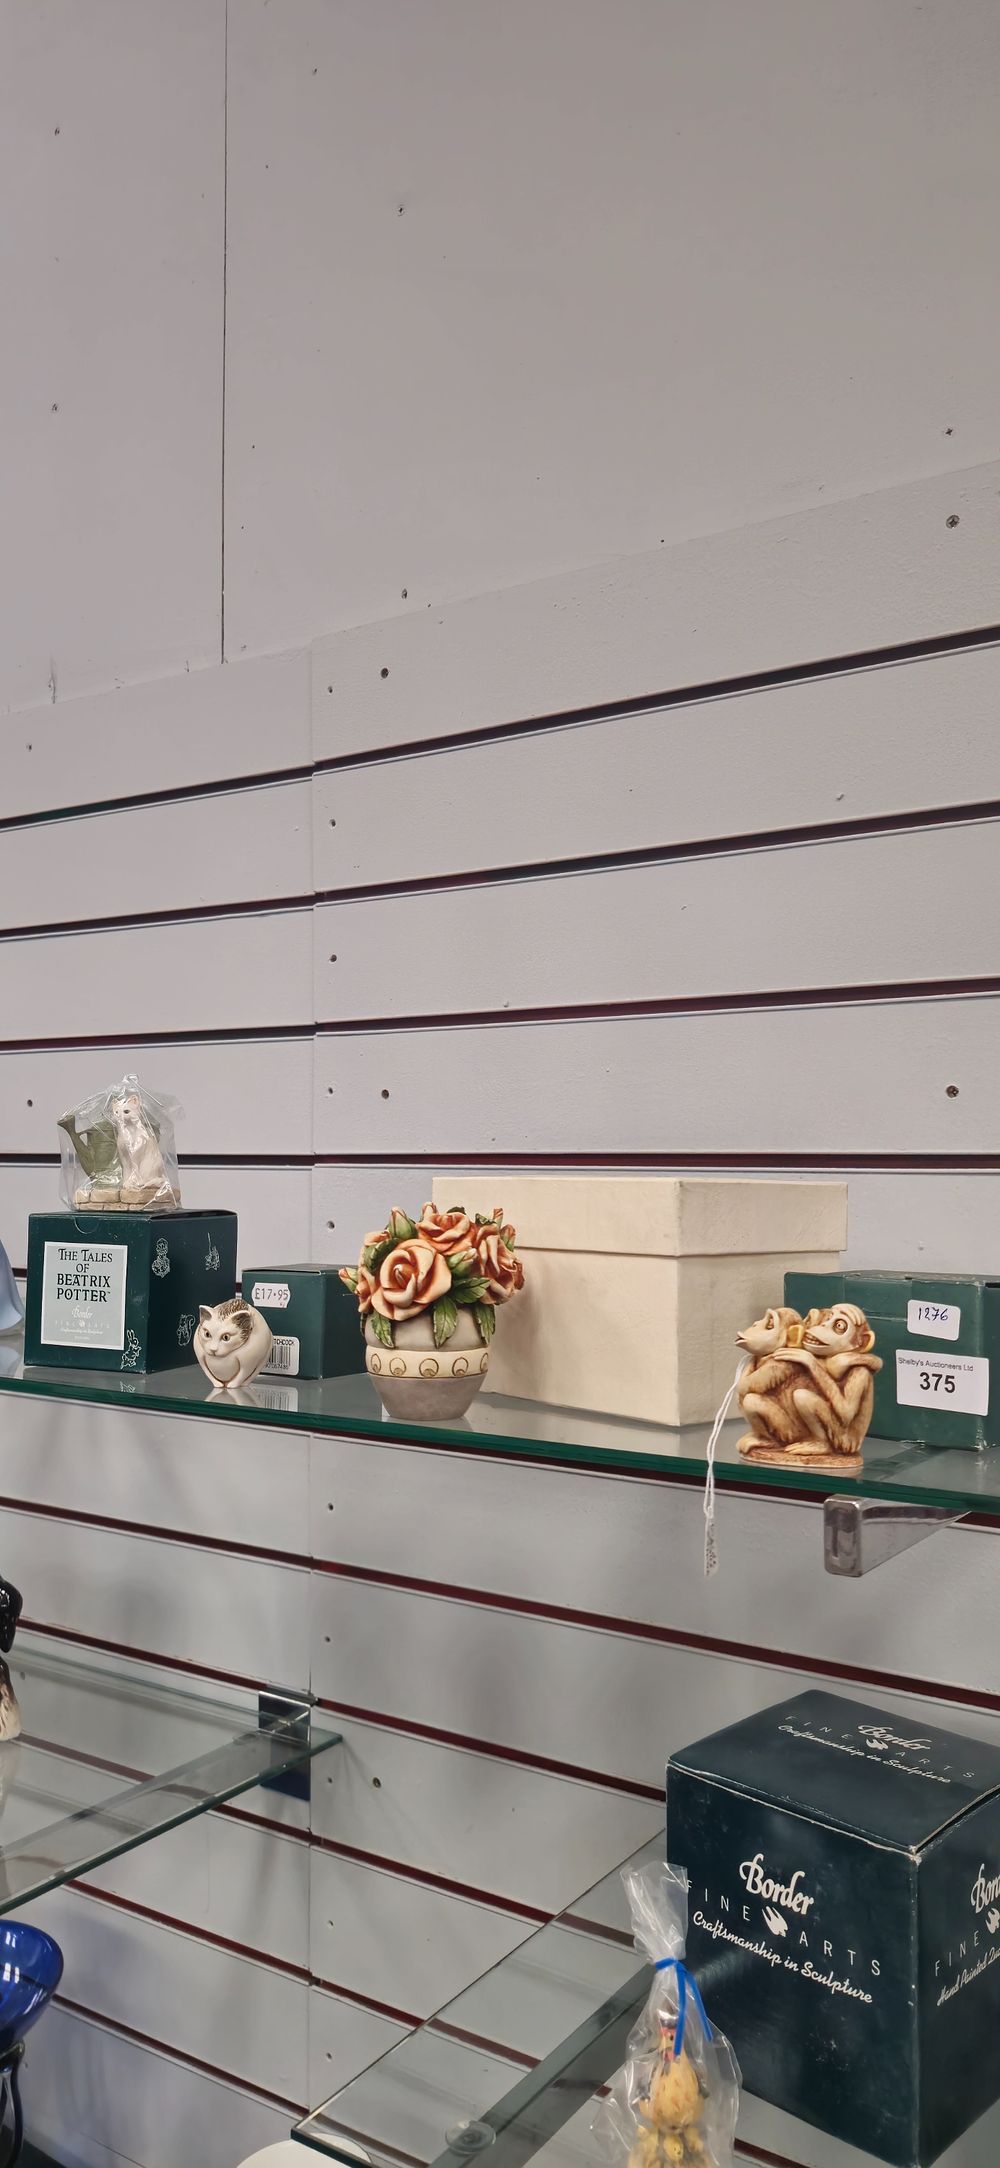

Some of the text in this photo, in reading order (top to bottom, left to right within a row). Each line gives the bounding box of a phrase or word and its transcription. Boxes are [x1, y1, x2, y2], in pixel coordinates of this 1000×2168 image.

[58, 1248, 113, 1263] THE TALES
[76, 1263, 90, 1273] OF
[57, 1273, 111, 1288] BEATRIX
[918, 1307, 949, 1321] 1276
[898, 1357, 974, 1372] Shelby's Auctioneers Ltd
[919, 1372, 956, 1393] 375
[777, 1724, 951, 1784] Craftsmanship in Sculpture
[785, 1715, 975, 1779] FINE ARTS
[857, 1725, 933, 1751] Border
[739, 1853, 815, 1916] Border
[970, 1863, 1000, 1914] Bor
[693, 1911, 873, 2005] Craftsmanship in Sculpture
[799, 1931, 881, 1976] ARTS
[935, 1930, 979, 1977] FINE
